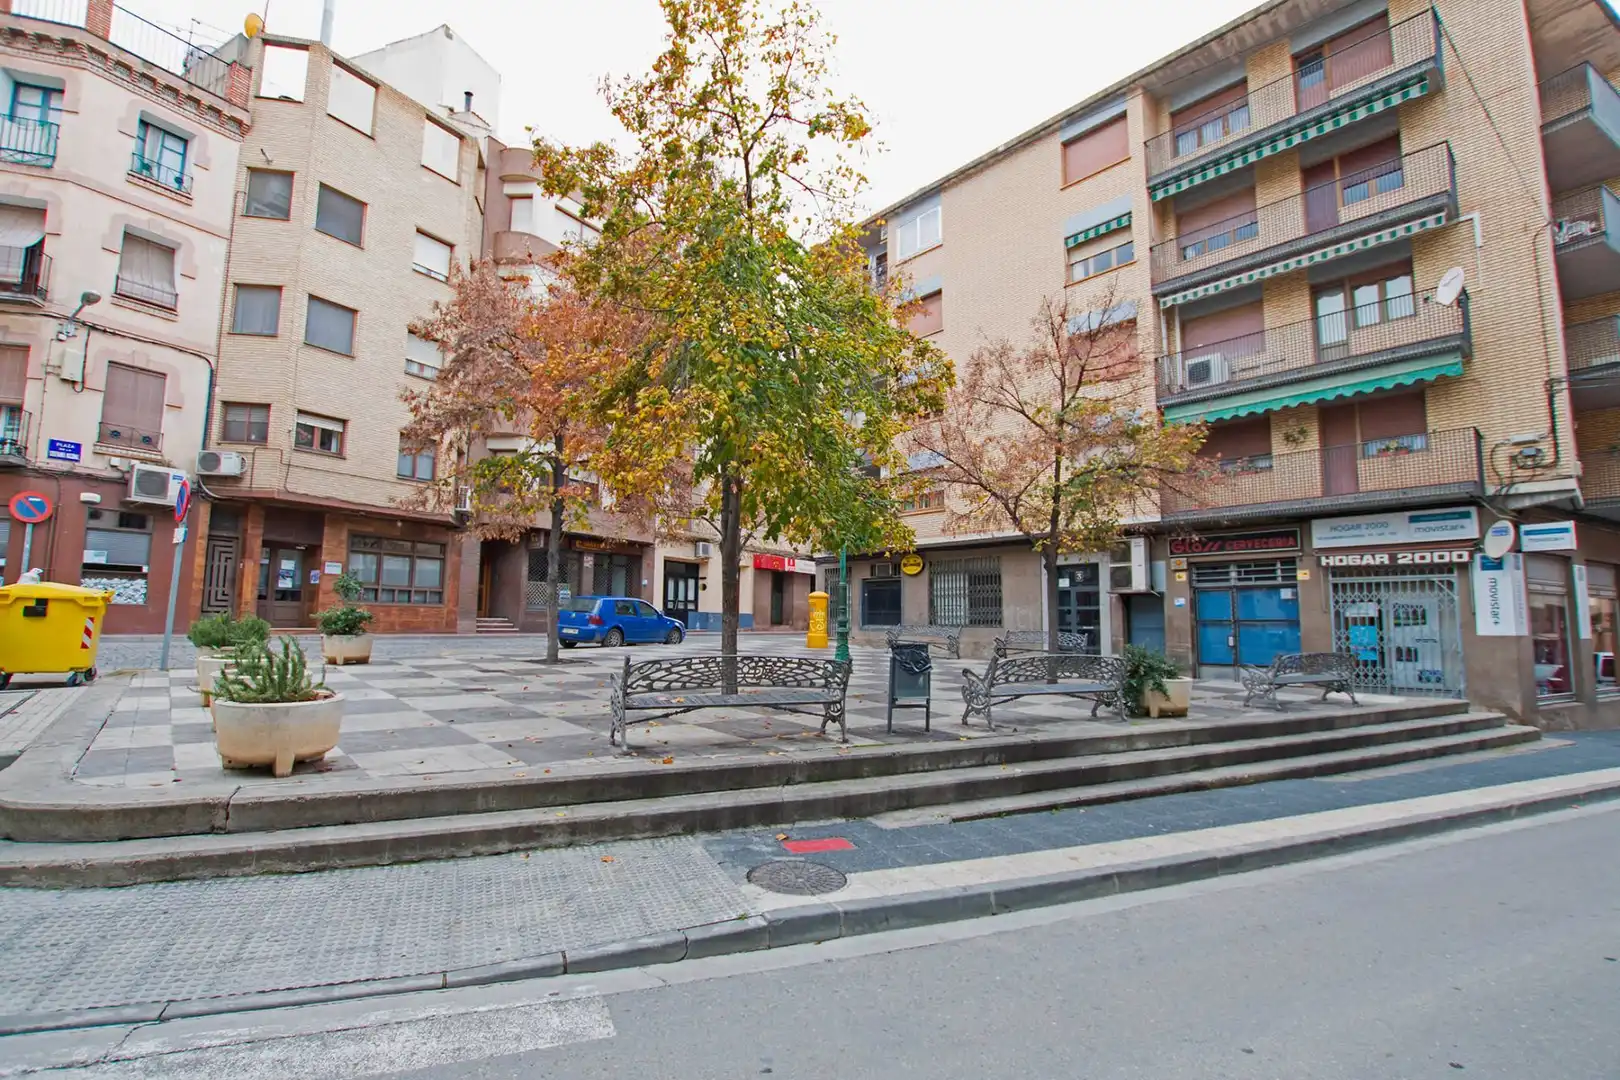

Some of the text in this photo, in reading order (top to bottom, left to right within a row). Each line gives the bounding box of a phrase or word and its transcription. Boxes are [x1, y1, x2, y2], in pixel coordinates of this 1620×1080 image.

[1330, 521, 1389, 532] HOGAR 2000
[1321, 553, 1389, 566] HOGAR
[1397, 551, 1469, 564] 2000
